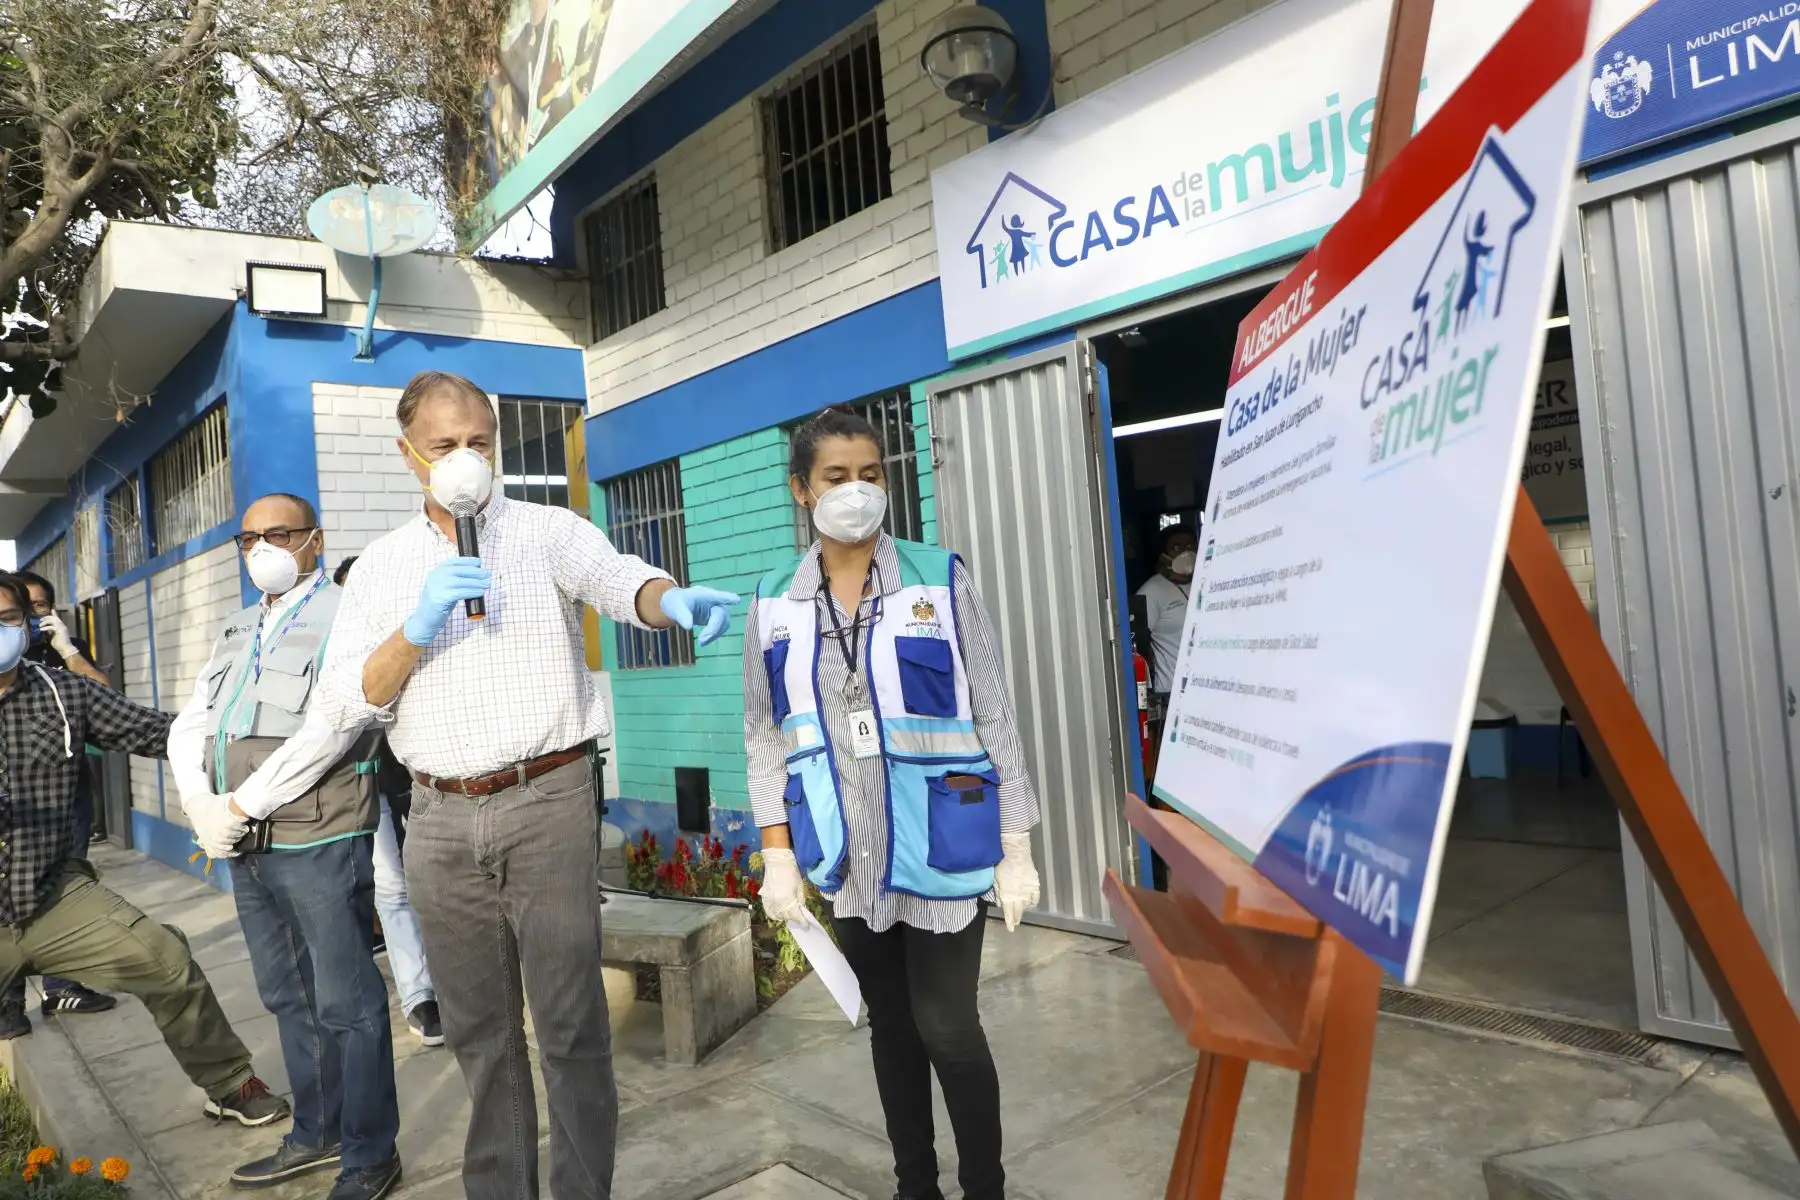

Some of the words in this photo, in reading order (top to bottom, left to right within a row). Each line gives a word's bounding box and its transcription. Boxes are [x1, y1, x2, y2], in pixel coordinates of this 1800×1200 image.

[1686, 2, 1800, 51] MUNICIPALID
[1207, 76, 1428, 213] muje
[1049, 185, 1180, 268] CASA
[1173, 171, 1204, 198] de
[1185, 197, 1206, 222] la
[1238, 269, 1318, 373] ALBERGUE
[1360, 320, 1430, 410] CASA
[1227, 391, 1261, 437] Casa
[1261, 366, 1282, 414] de
[1283, 352, 1301, 399] la
[1301, 304, 1367, 385] Mujer
[1379, 343, 1498, 460] mujer
[1528, 435, 1572, 457] legal,
[1554, 459, 1565, 476] y
[1333, 852, 1399, 938] LIMA
